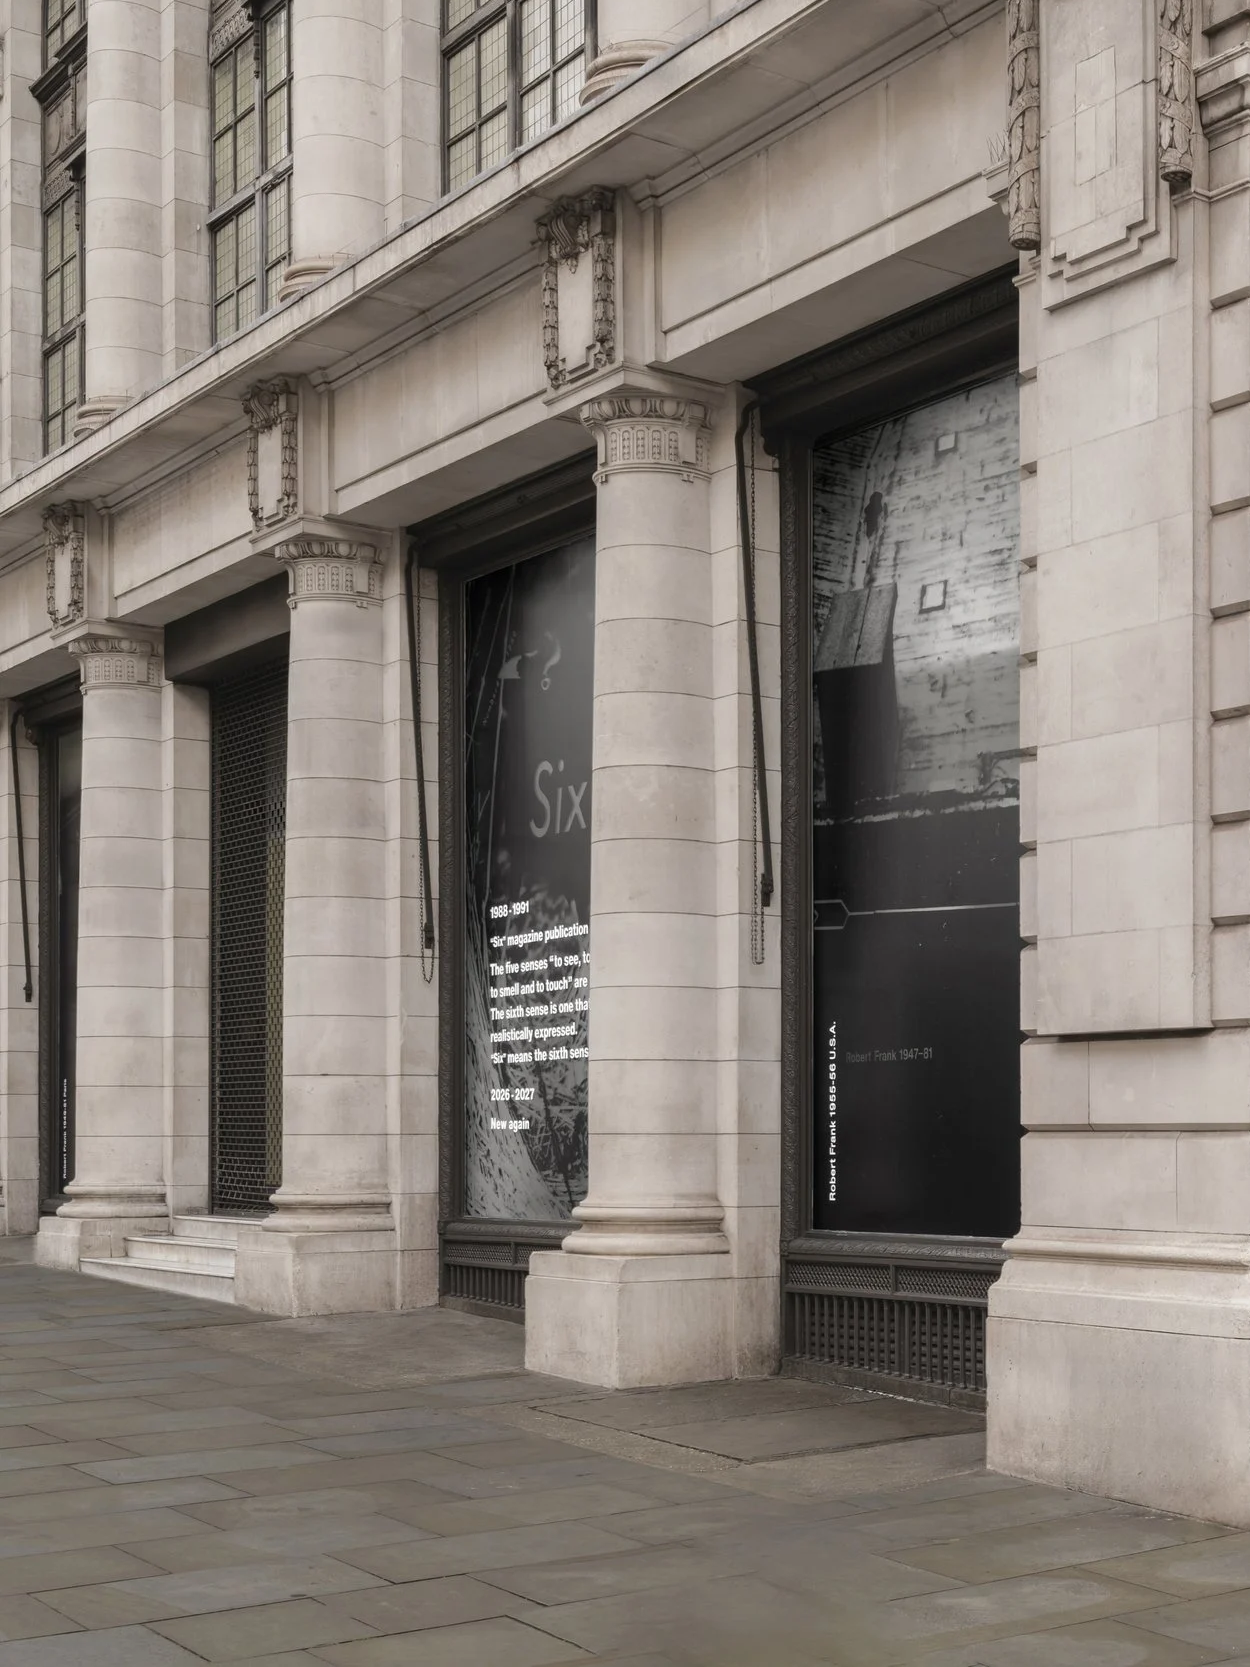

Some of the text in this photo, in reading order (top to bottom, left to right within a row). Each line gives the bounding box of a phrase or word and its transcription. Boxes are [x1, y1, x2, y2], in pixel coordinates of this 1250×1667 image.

[530, 759, 588, 837] Six
[507, 930, 544, 947] magazine
[544, 922, 588, 944] publication
[490, 963, 504, 976] The
[505, 961, 520, 974] five
[520, 959, 548, 972] senses
[564, 954, 582, 967] see,
[490, 986, 498, 998] to
[500, 982, 520, 997] smell
[520, 980, 534, 994] and
[536, 981, 544, 992] to
[574, 977, 588, 988] are
[490, 998, 590, 1020] The sixth sense is one tha
[490, 1022, 578, 1042] realistically expressed.
[508, 1052, 532, 1064] means
[534, 1048, 548, 1062] the
[548, 1046, 568, 1060] sixth
[570, 1047, 589, 1058] sens
[846, 1051, 872, 1063] Robert
[874, 1050, 896, 1062] Frank
[828, 1021, 836, 1201] Robert Frank 1955-56 U.S.A.
[490, 1118, 530, 1132] New again
